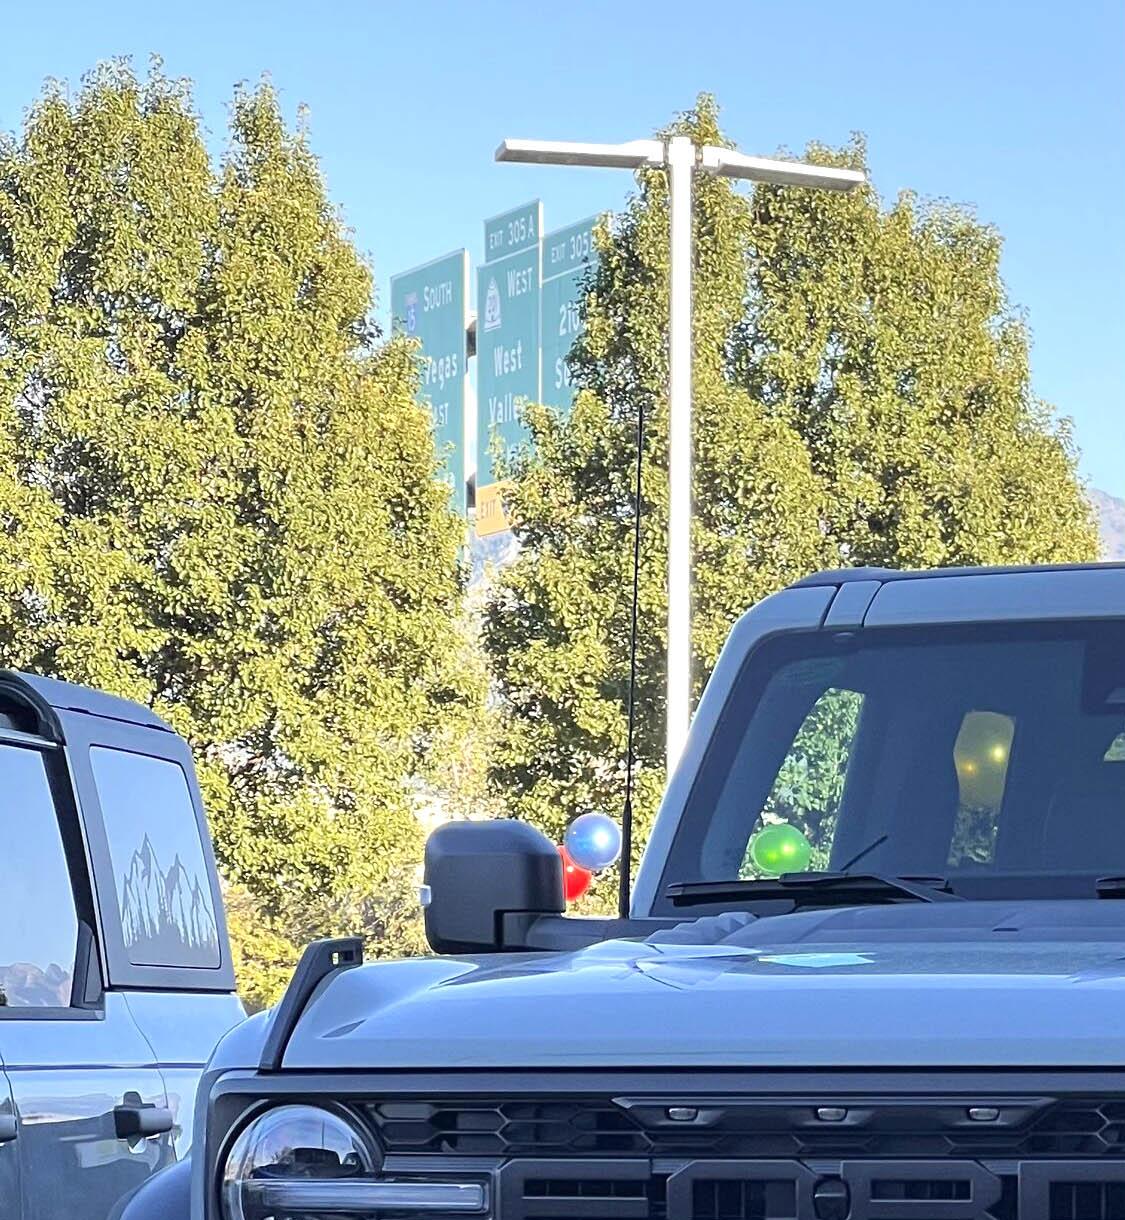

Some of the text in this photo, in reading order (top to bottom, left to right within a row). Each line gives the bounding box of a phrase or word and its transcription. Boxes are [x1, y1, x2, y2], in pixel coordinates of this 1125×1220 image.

[490, 230, 504, 249] EXIT
[423, 281, 452, 312] SOUTH
[507, 268, 533, 298] WEST
[494, 339, 522, 377] West
[488, 392, 525, 425] Valle
